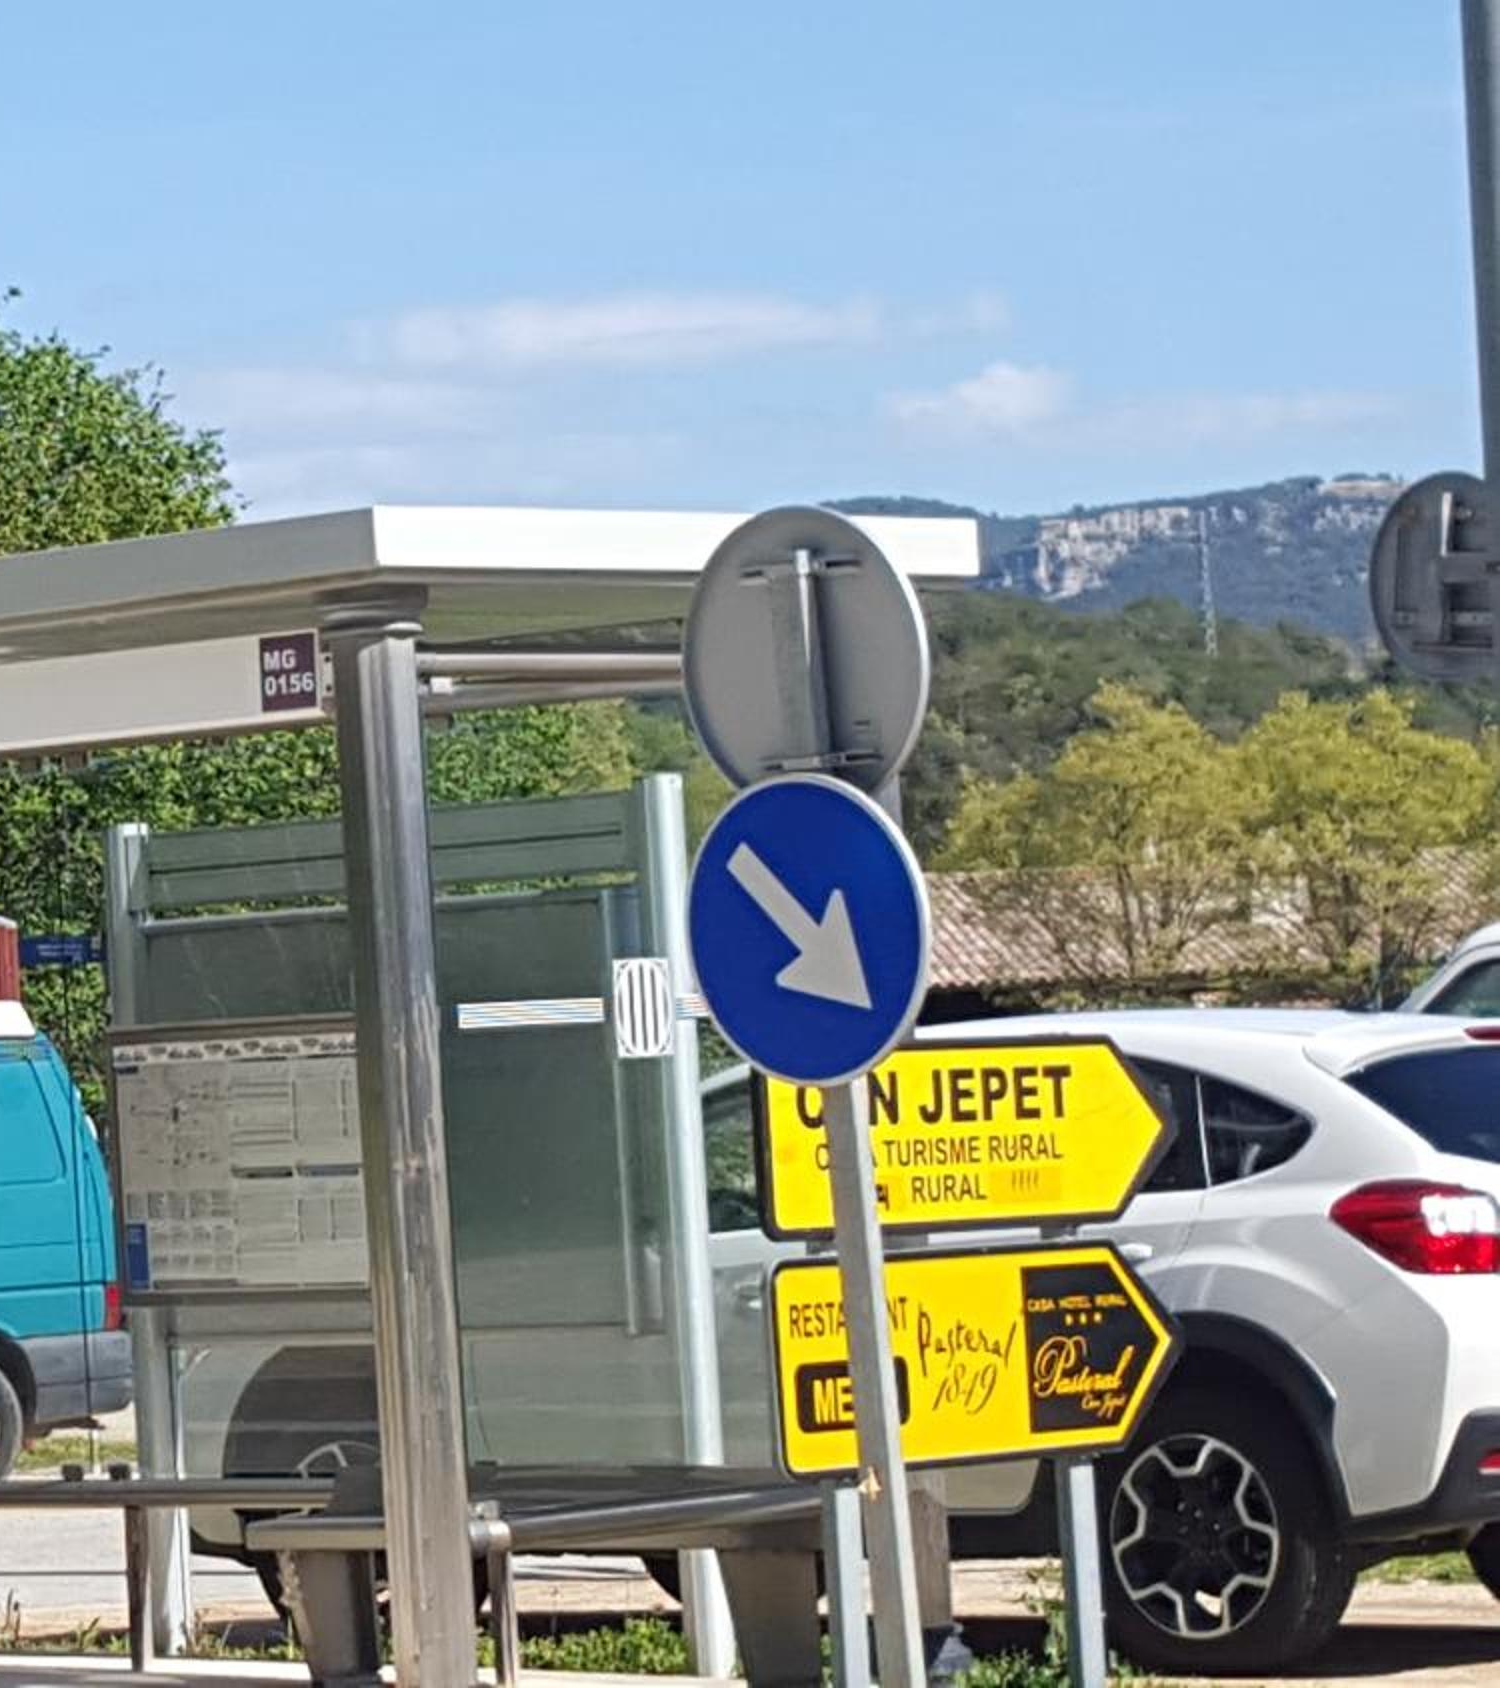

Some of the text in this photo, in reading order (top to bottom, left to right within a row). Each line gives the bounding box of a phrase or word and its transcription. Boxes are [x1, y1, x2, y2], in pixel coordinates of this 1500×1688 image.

[263, 649, 297, 672] MG
[264, 671, 315, 696] 0156
[919, 1064, 1072, 1125] JEPET
[884, 1138, 981, 1167] TURISME
[989, 1132, 1063, 1162] RURAL
[911, 1173, 988, 1204] RURAL
